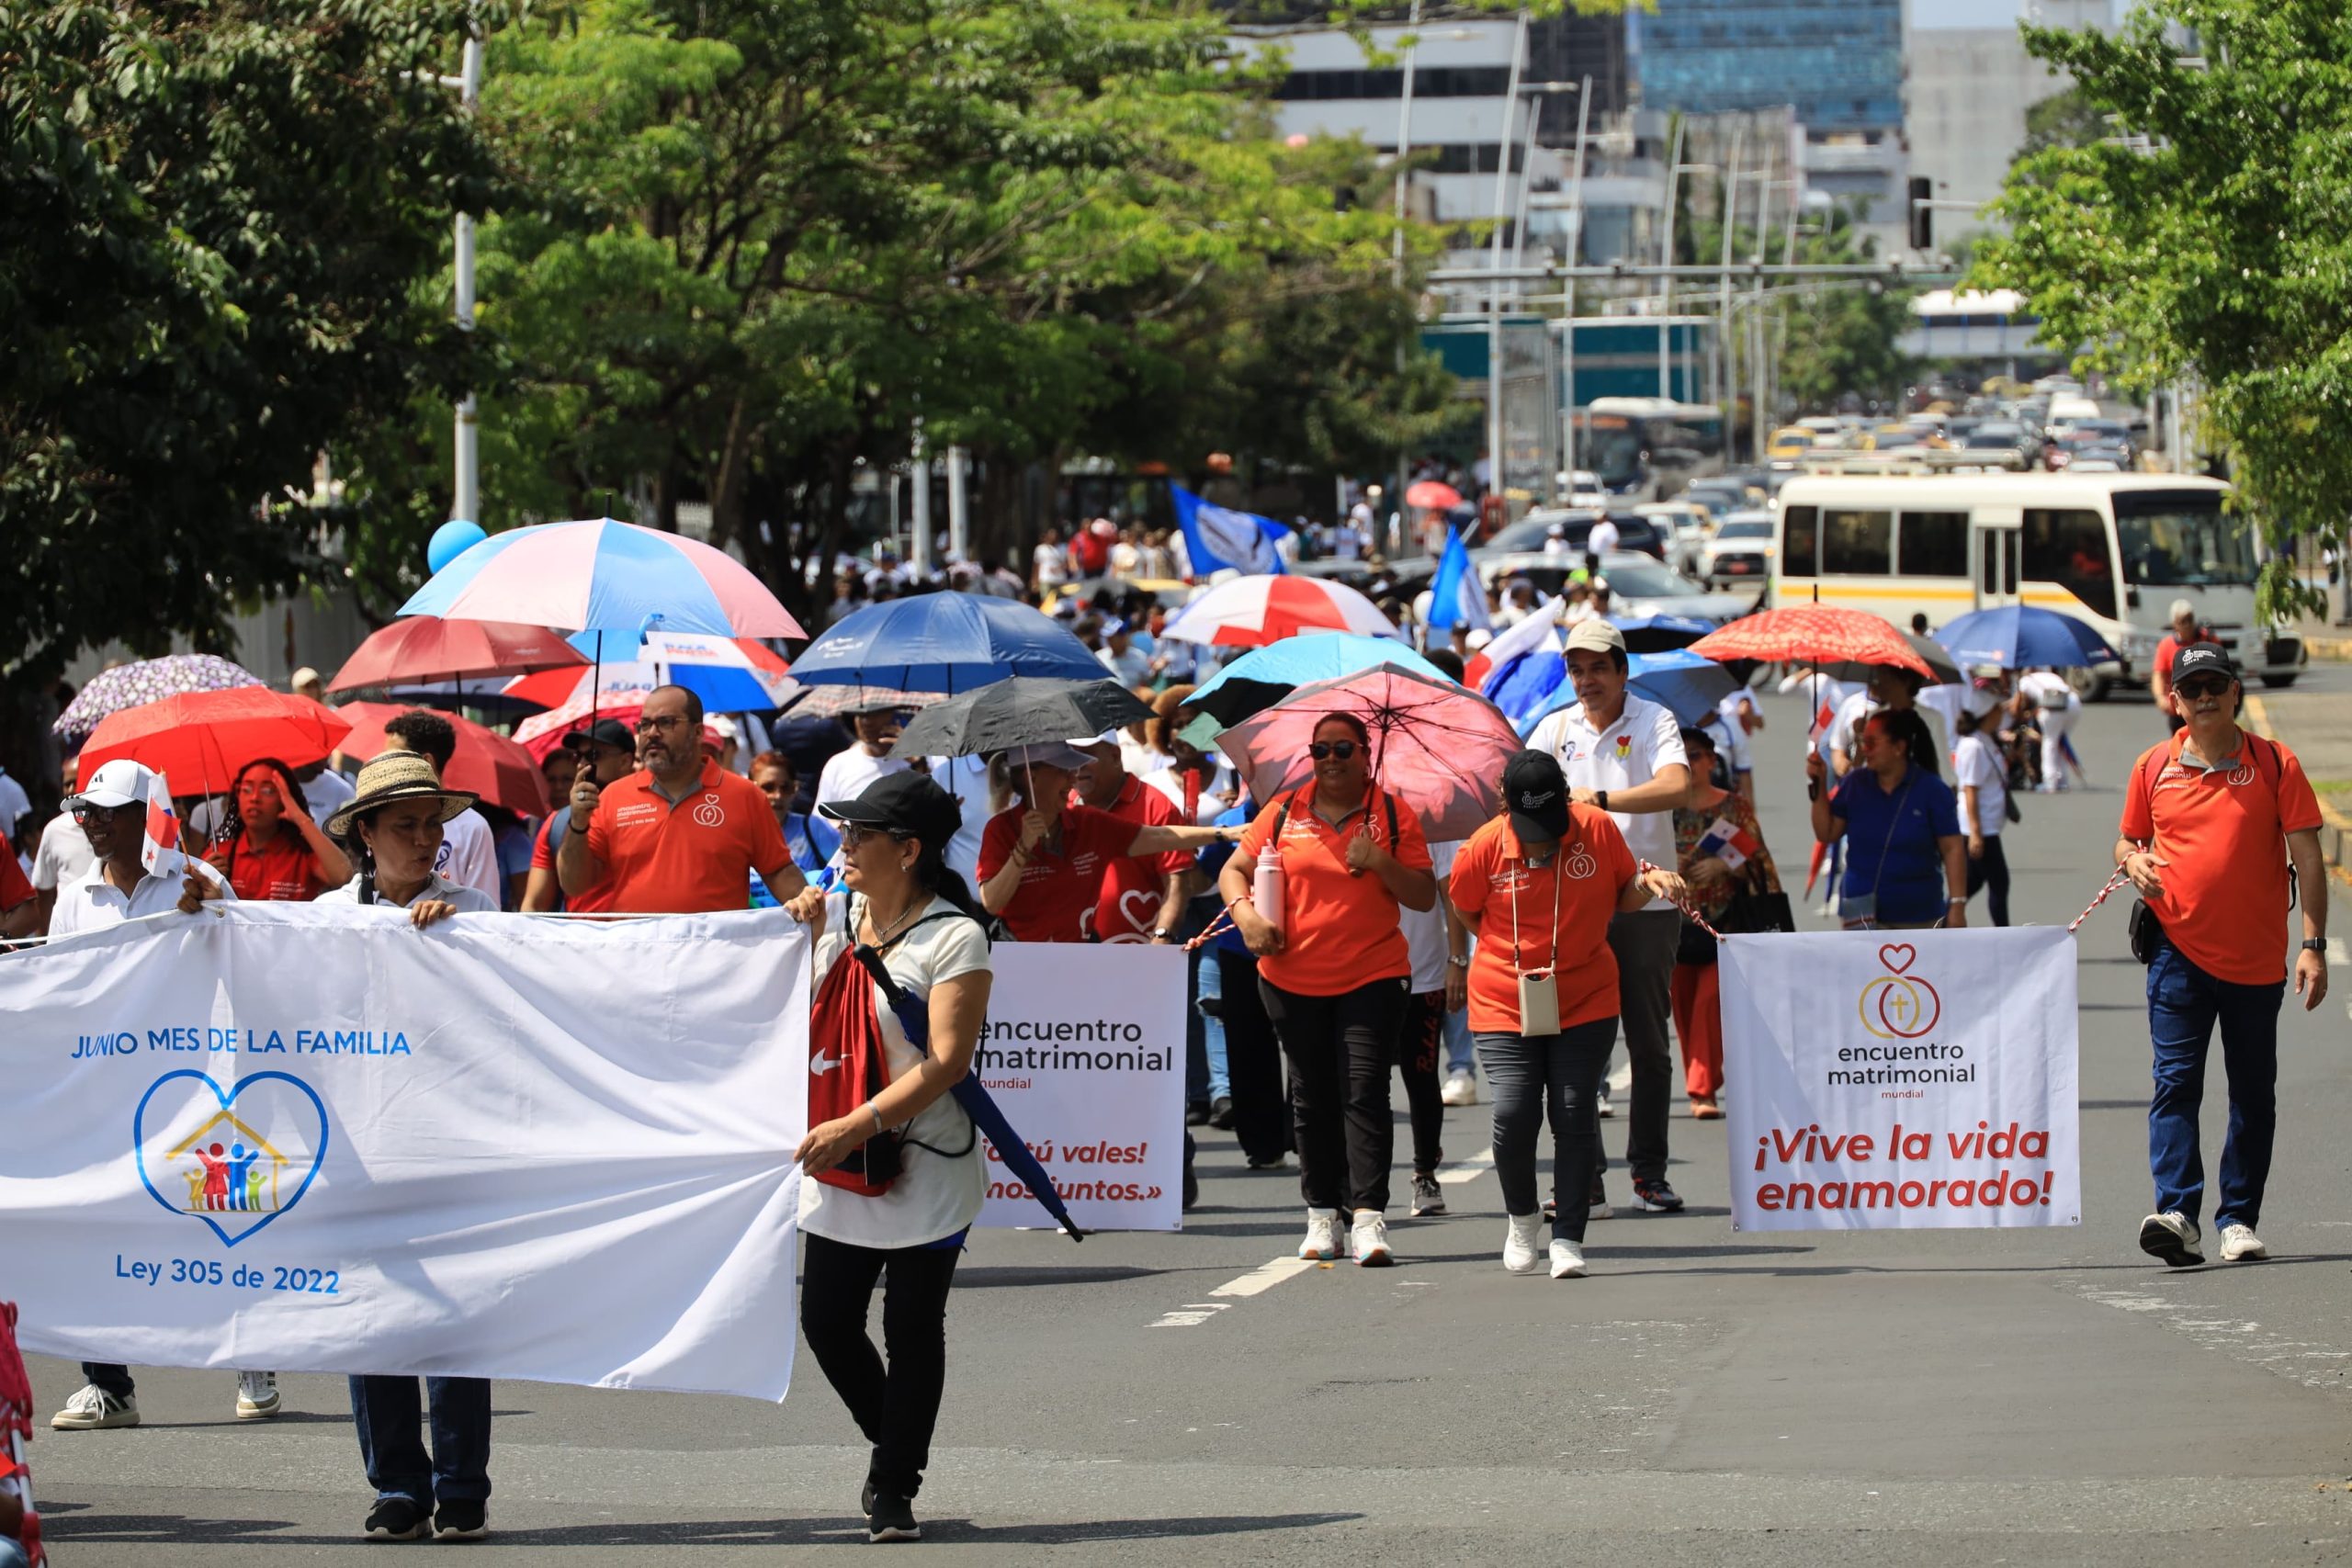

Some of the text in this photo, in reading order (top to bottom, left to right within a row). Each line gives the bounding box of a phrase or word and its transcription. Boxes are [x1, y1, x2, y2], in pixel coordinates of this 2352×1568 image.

[71, 1025, 413, 1059] JUNIO MES DE LA FAMILIA
[1838, 1042, 1965, 1063] encuentro
[974, 1043, 1172, 1072] matrimonial
[1827, 1063, 1976, 1087] matrimonial
[1881, 1089, 1925, 1100] mundial
[1062, 1139, 1148, 1165] vales!
[1754, 1120, 2051, 1172] ¡Vive la vida
[1755, 1169, 2054, 1213] enamorado!
[115, 1253, 340, 1295] Ley 305 de 2022
